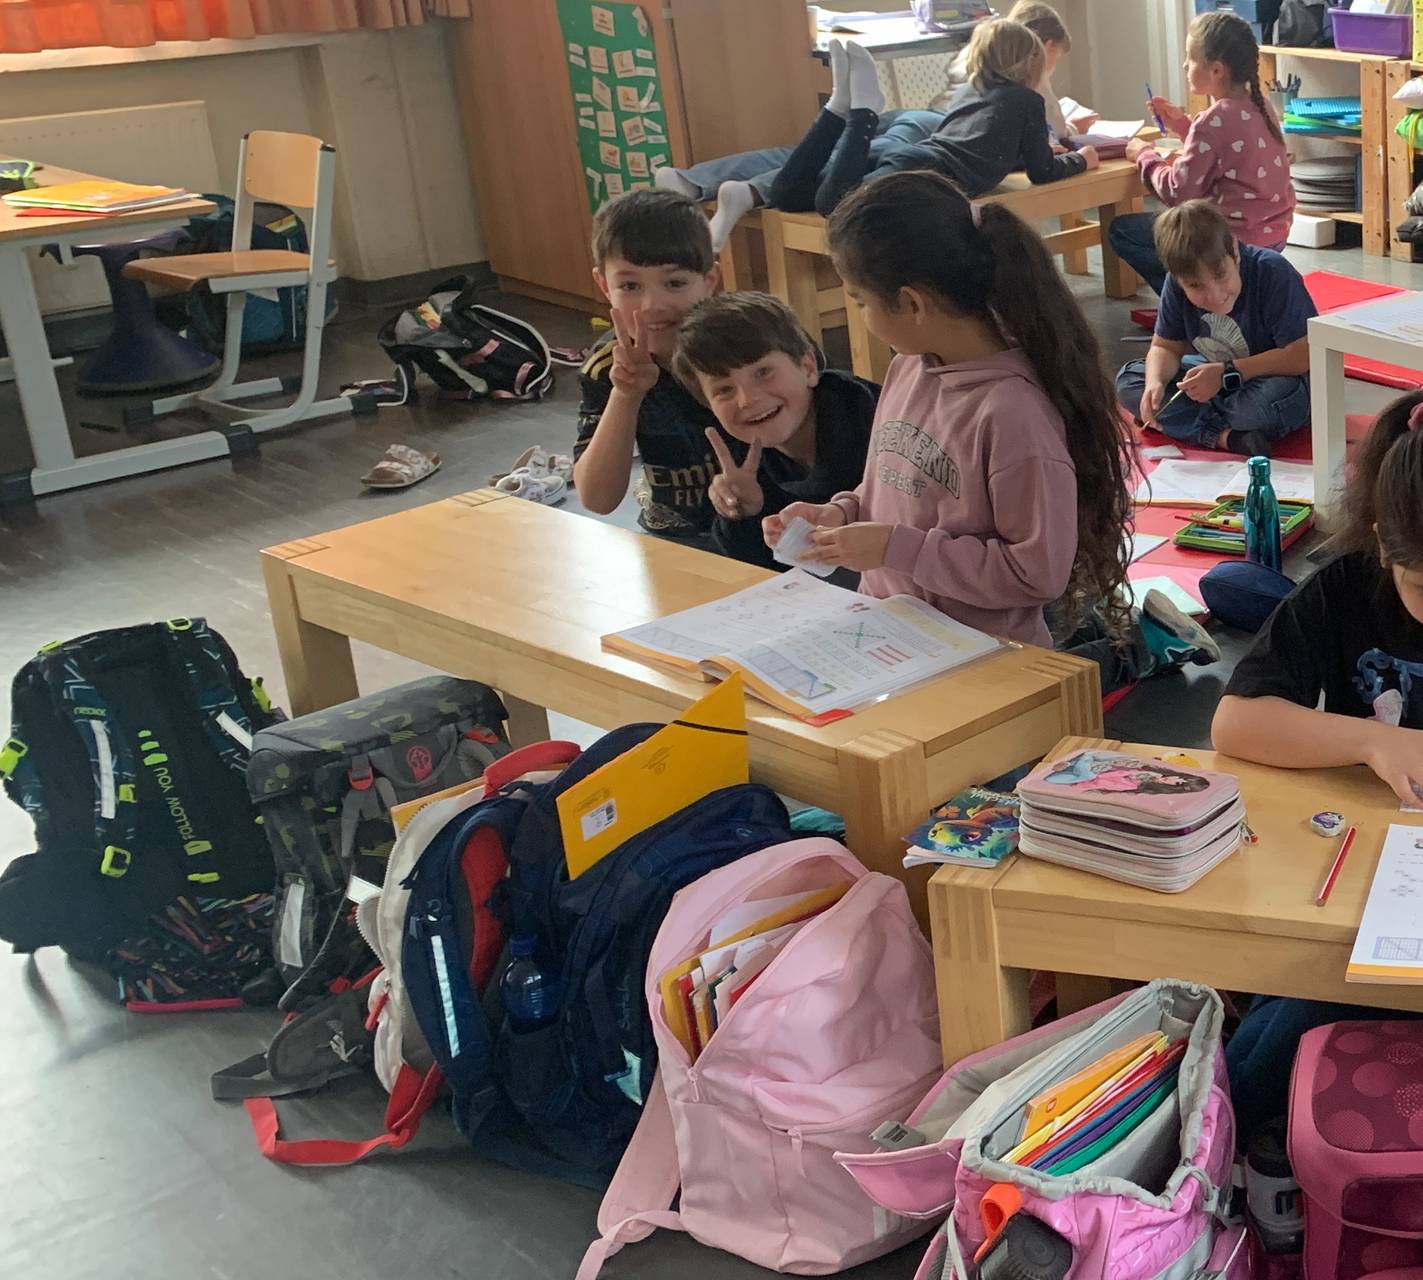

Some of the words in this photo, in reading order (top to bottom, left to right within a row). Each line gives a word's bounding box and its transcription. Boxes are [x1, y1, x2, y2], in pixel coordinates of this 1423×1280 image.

[642, 454, 715, 487] Emi
[875, 420, 960, 499] EEKEND
[879, 464, 927, 498] EPEAT
[675, 489, 705, 507] FLY
[153, 767, 175, 793] YOU
[165, 797, 197, 841] FOLLOW
